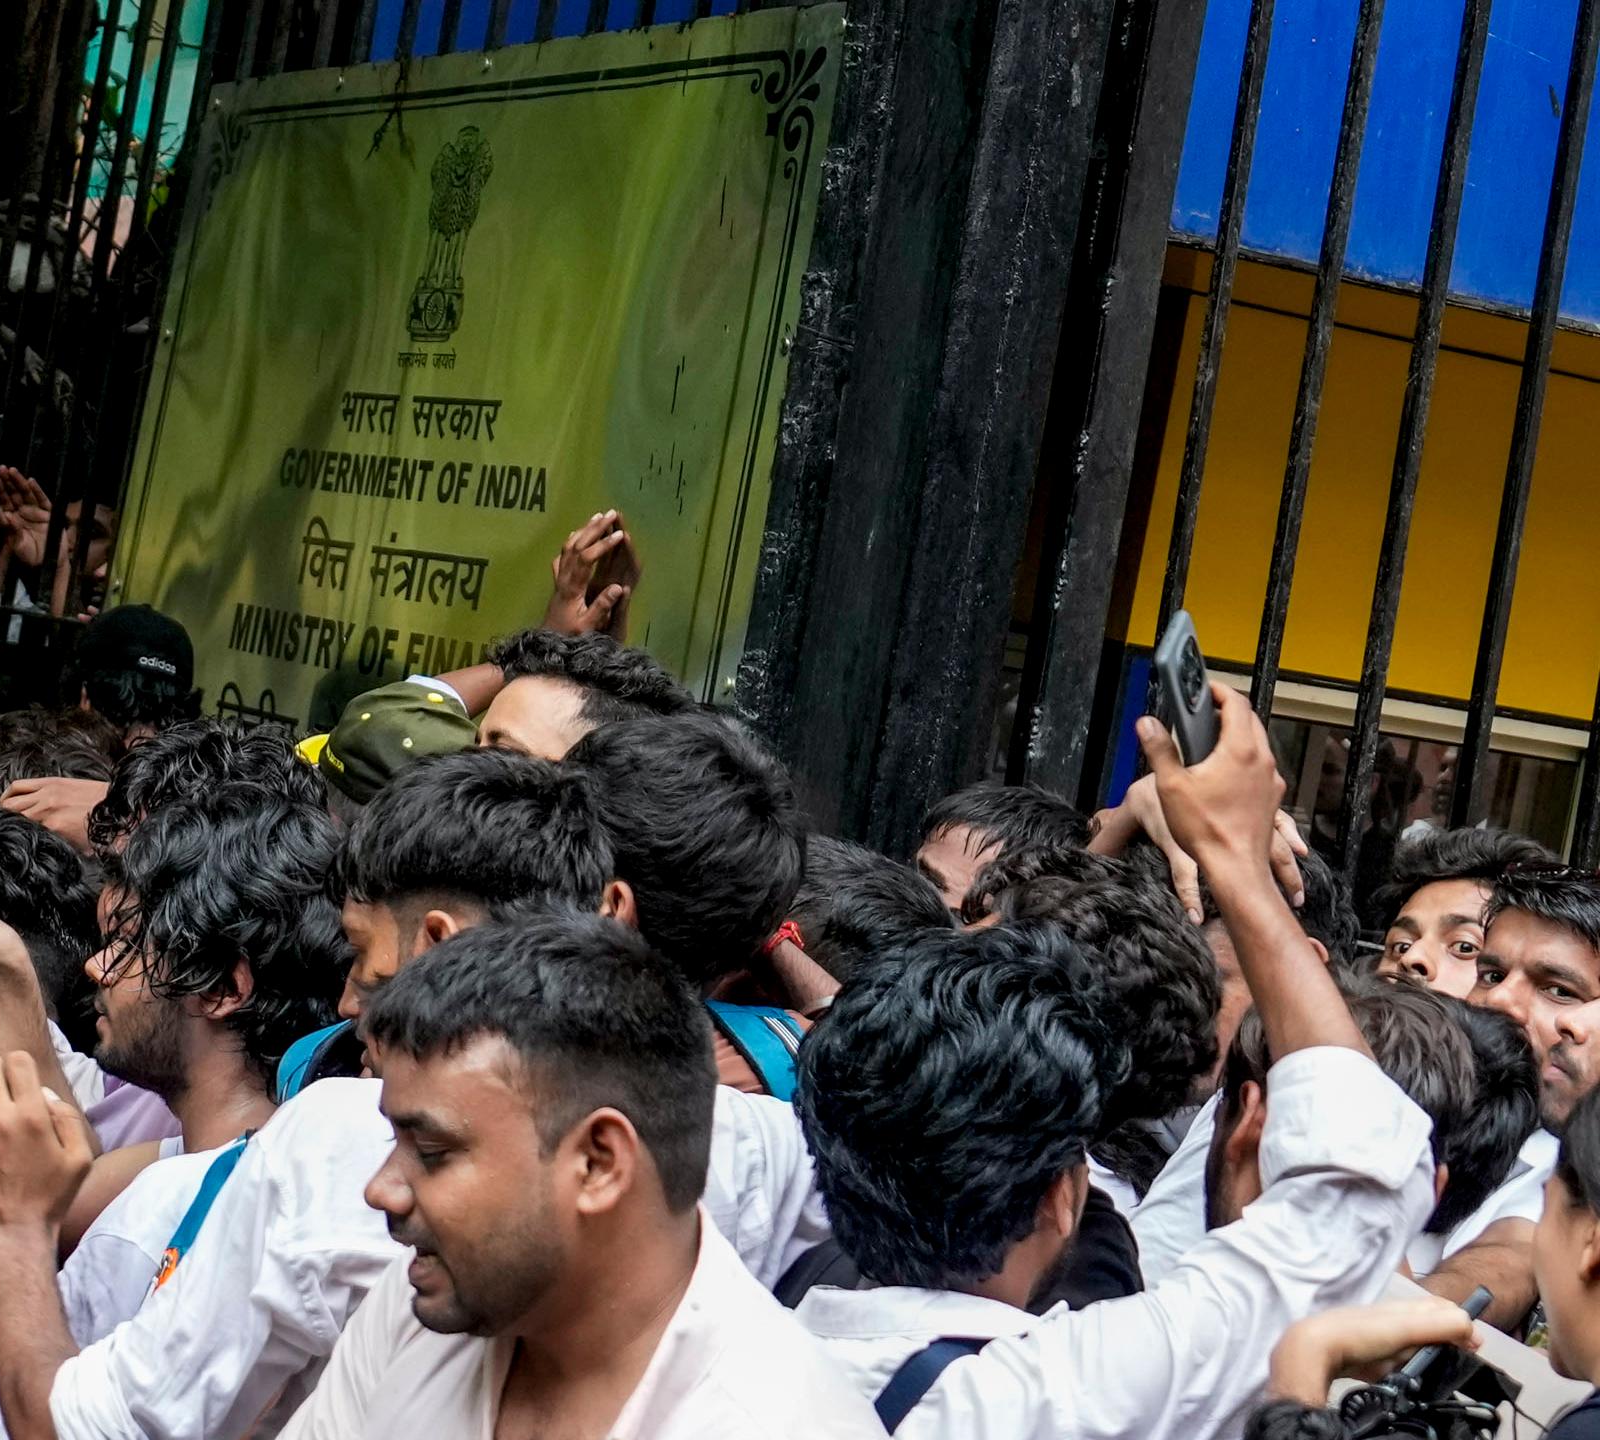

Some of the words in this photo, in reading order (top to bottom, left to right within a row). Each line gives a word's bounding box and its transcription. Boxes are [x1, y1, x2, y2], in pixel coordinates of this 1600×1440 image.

[432, 347, 456, 371] जयते
[342, 391, 401, 436] भारत
[412, 395, 503, 442] सरकार
[280, 447, 435, 502] GOVERNMENT
[436, 461, 474, 505] OF
[474, 463, 547, 513] INDIA
[299, 516, 355, 592] वित्त
[371, 532, 490, 611] मंत्रालय
[138, 656, 177, 674] adidas
[228, 602, 356, 673] MINISTRY
[357, 626, 401, 678] OF
